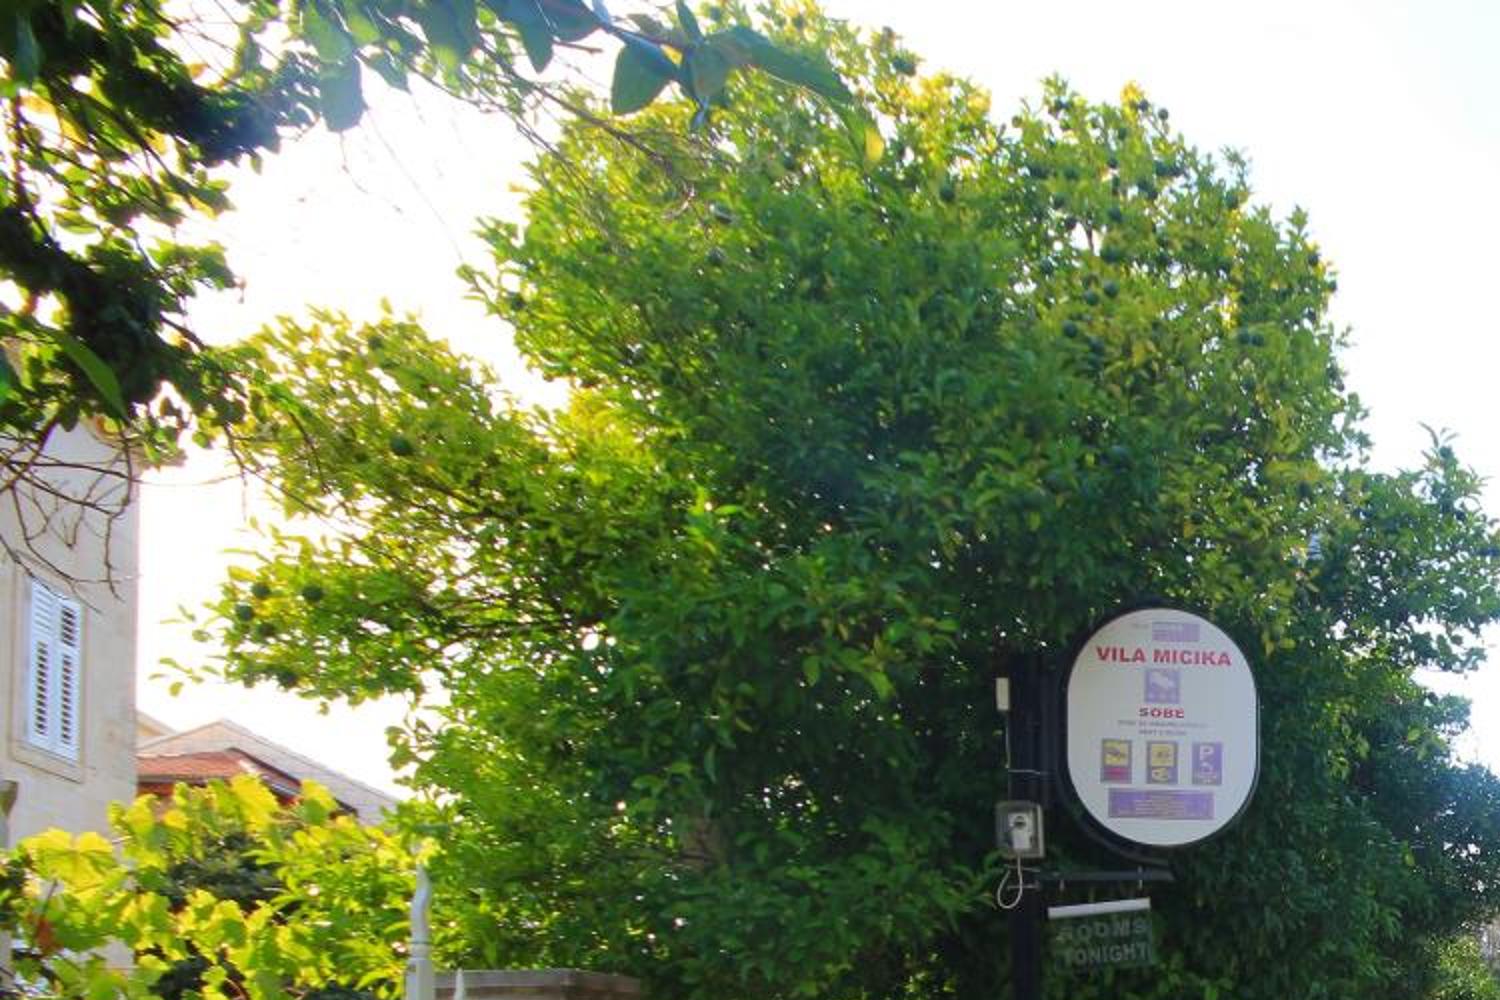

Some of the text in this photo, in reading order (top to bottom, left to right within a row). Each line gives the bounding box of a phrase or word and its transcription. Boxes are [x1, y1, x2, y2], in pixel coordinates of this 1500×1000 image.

[1096, 645, 1233, 667] VILA MICIKA
[1138, 707, 1185, 719] SOBE
